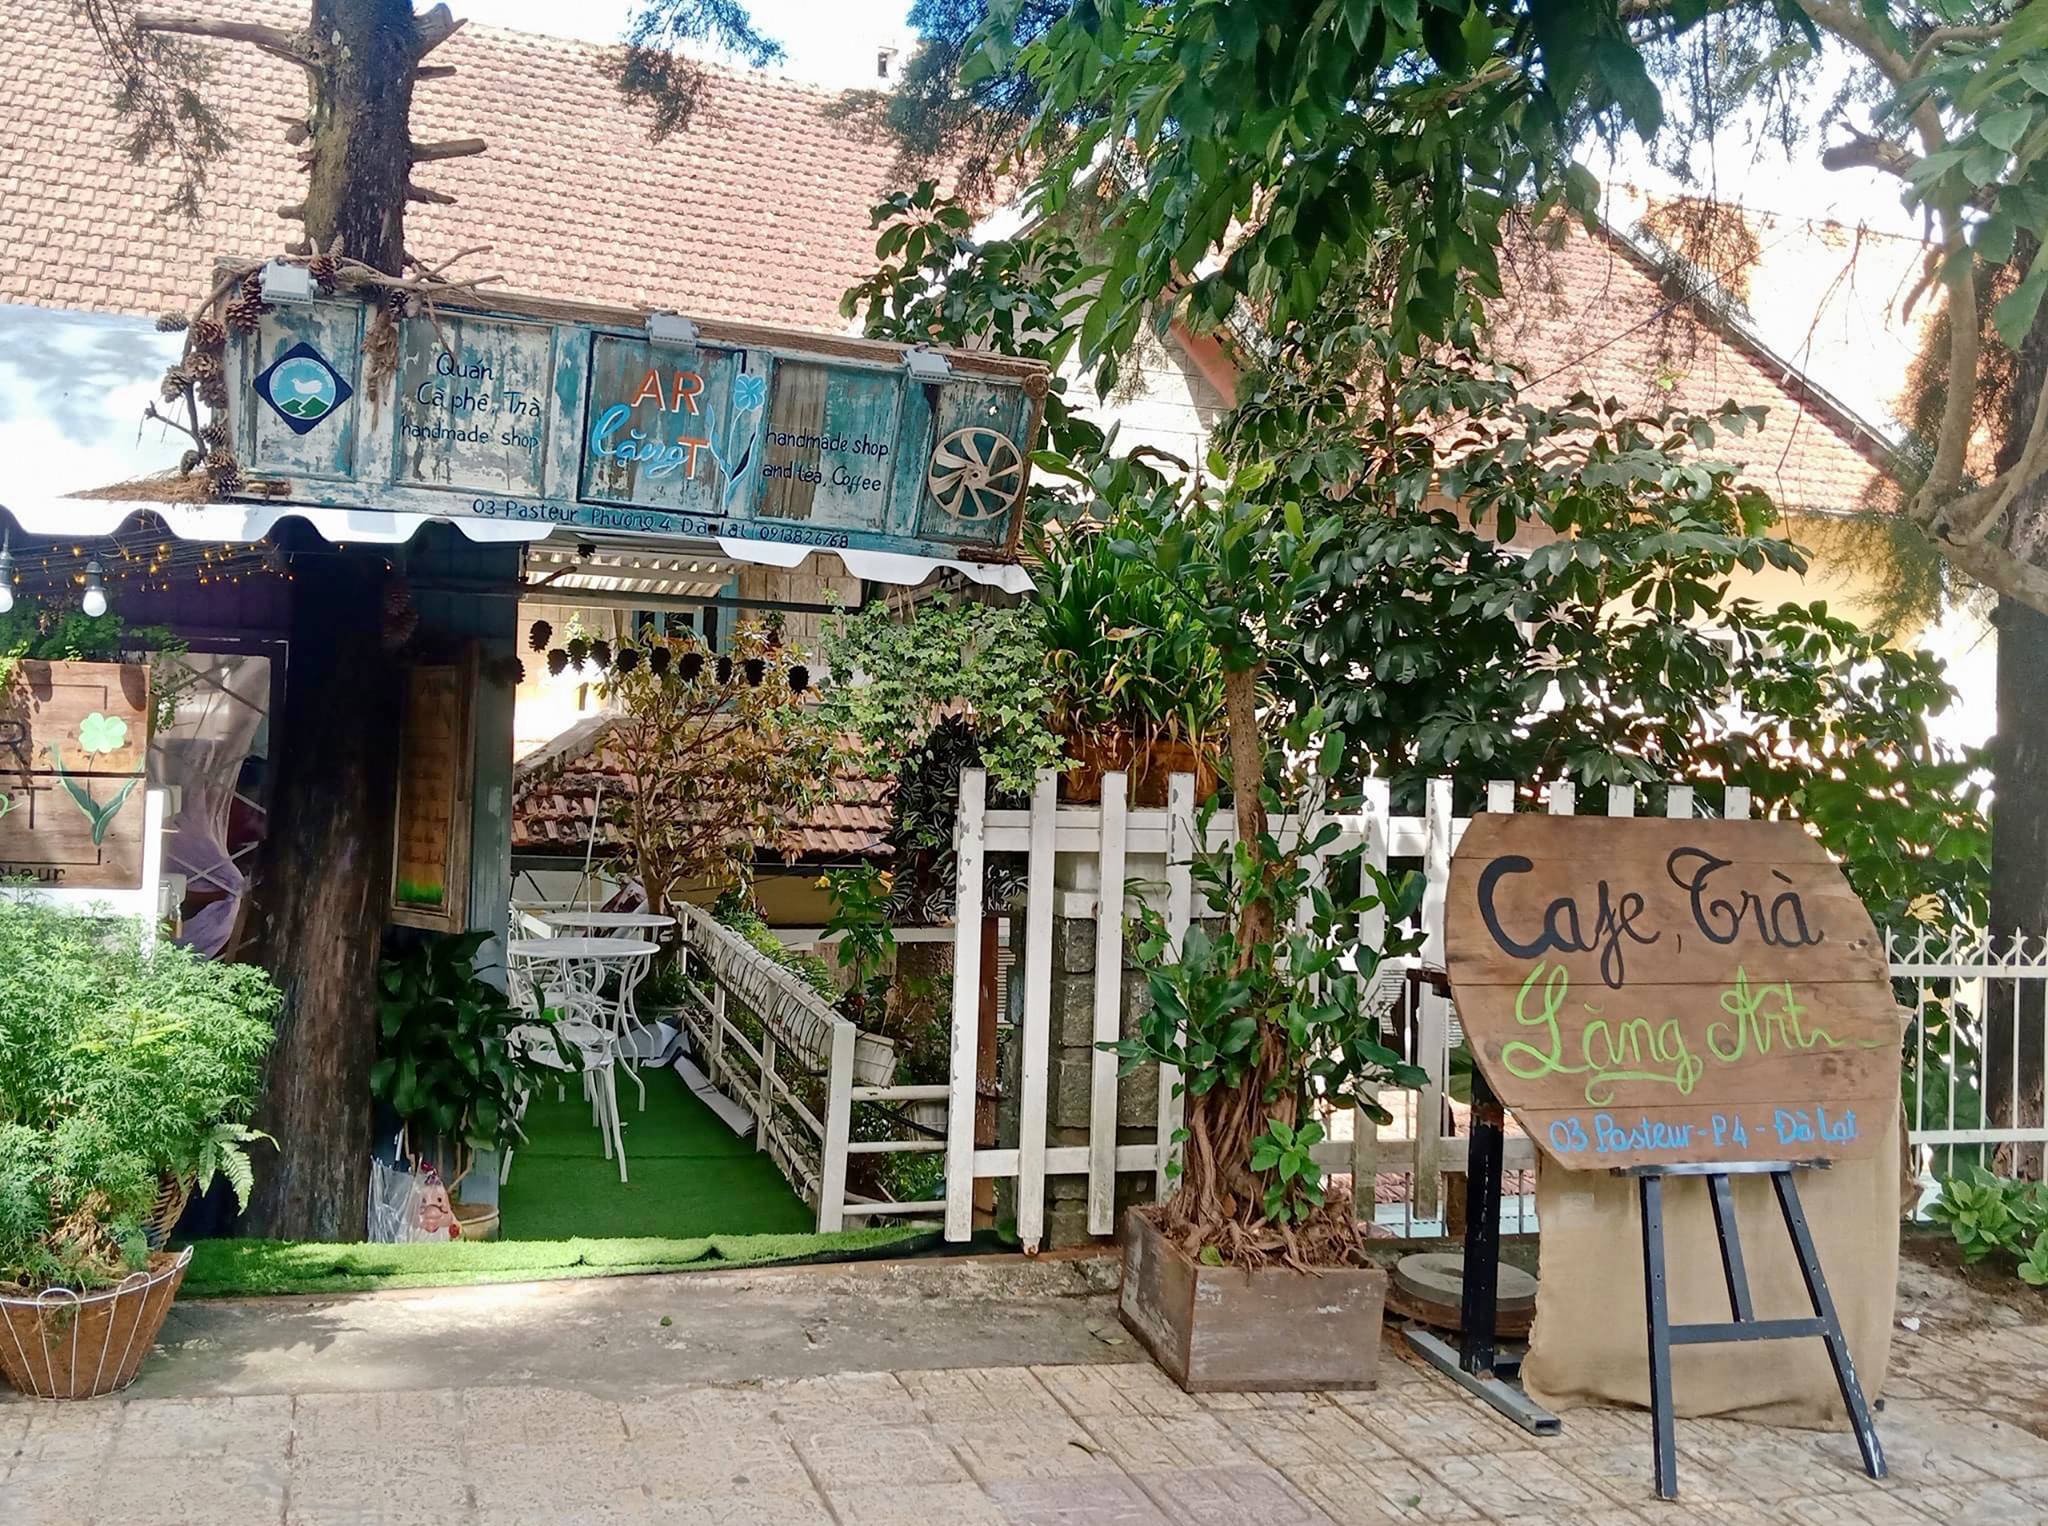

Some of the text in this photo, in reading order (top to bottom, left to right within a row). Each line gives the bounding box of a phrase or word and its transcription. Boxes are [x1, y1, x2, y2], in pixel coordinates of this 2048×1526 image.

[437, 352, 495, 381] Quán
[503, 391, 541, 417] Trà
[631, 368, 705, 416] AR
[401, 416, 540, 454] handmade shop
[765, 424, 890, 462] handmade shop
[762, 461, 793, 480] and
[832, 466, 882, 495] Coffee
[505, 499, 579, 523] Pasteur
[759, 526, 848, 548] 0913826768
[1667, 848, 1824, 948] Trà
[1550, 1117, 1589, 1152] 03
